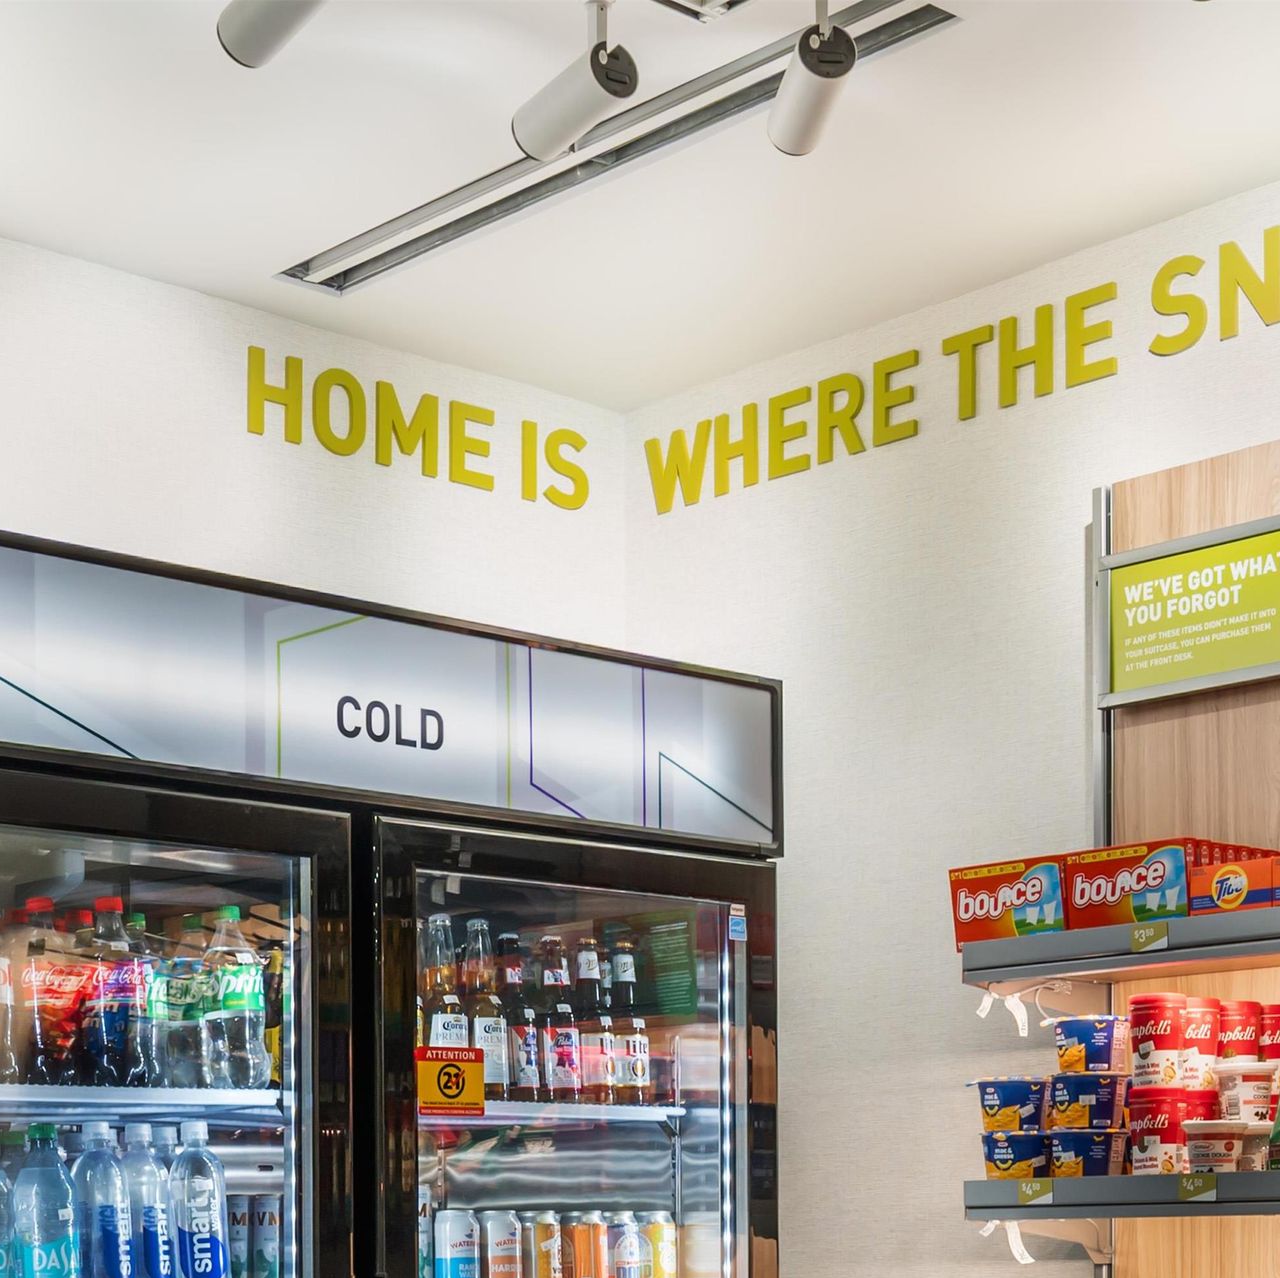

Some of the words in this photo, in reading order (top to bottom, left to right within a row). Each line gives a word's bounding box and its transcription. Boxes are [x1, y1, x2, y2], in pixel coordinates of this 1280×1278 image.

[246, 344, 495, 493] HOME
[520, 419, 589, 510] IS
[643, 348, 919, 515] WHERE
[943, 281, 1118, 421] THE
[1124, 574, 1183, 604] WE'VE
[1188, 564, 1225, 590] GOT
[1125, 602, 1161, 627] YOU
[1167, 585, 1242, 618] FORGOT
[1125, 637, 1131, 646] IF
[1133, 635, 1146, 644] ANY
[1148, 634, 1157, 642] OF
[1158, 629, 1180, 639] THESE
[1182, 624, 1202, 635] ITEMS
[1204, 619, 1228, 631] DIDN'T
[1229, 613, 1249, 623] MAKE
[1259, 608, 1276, 618] INTO
[1126, 648, 1143, 658] YOUR
[1180, 639, 1194, 648] YOU
[1196, 635, 1210, 644] CAN
[1212, 628, 1249, 641] PURCHASE
[1251, 622, 1271, 632] THEM
[1125, 663, 1134, 672] AT
[1136, 661, 1148, 669] THE
[1149, 656, 1172, 666] FRONT
[1173, 652, 1193, 661] DESK.
[335, 694, 445, 751] COLD
[956, 876, 1042, 922] bounce
[1072, 860, 1165, 907] bounce
[426, 1051, 475, 1059] ATTENTION
[443, 1071, 461, 1090] 21
[187, 1199, 212, 1273] smart
